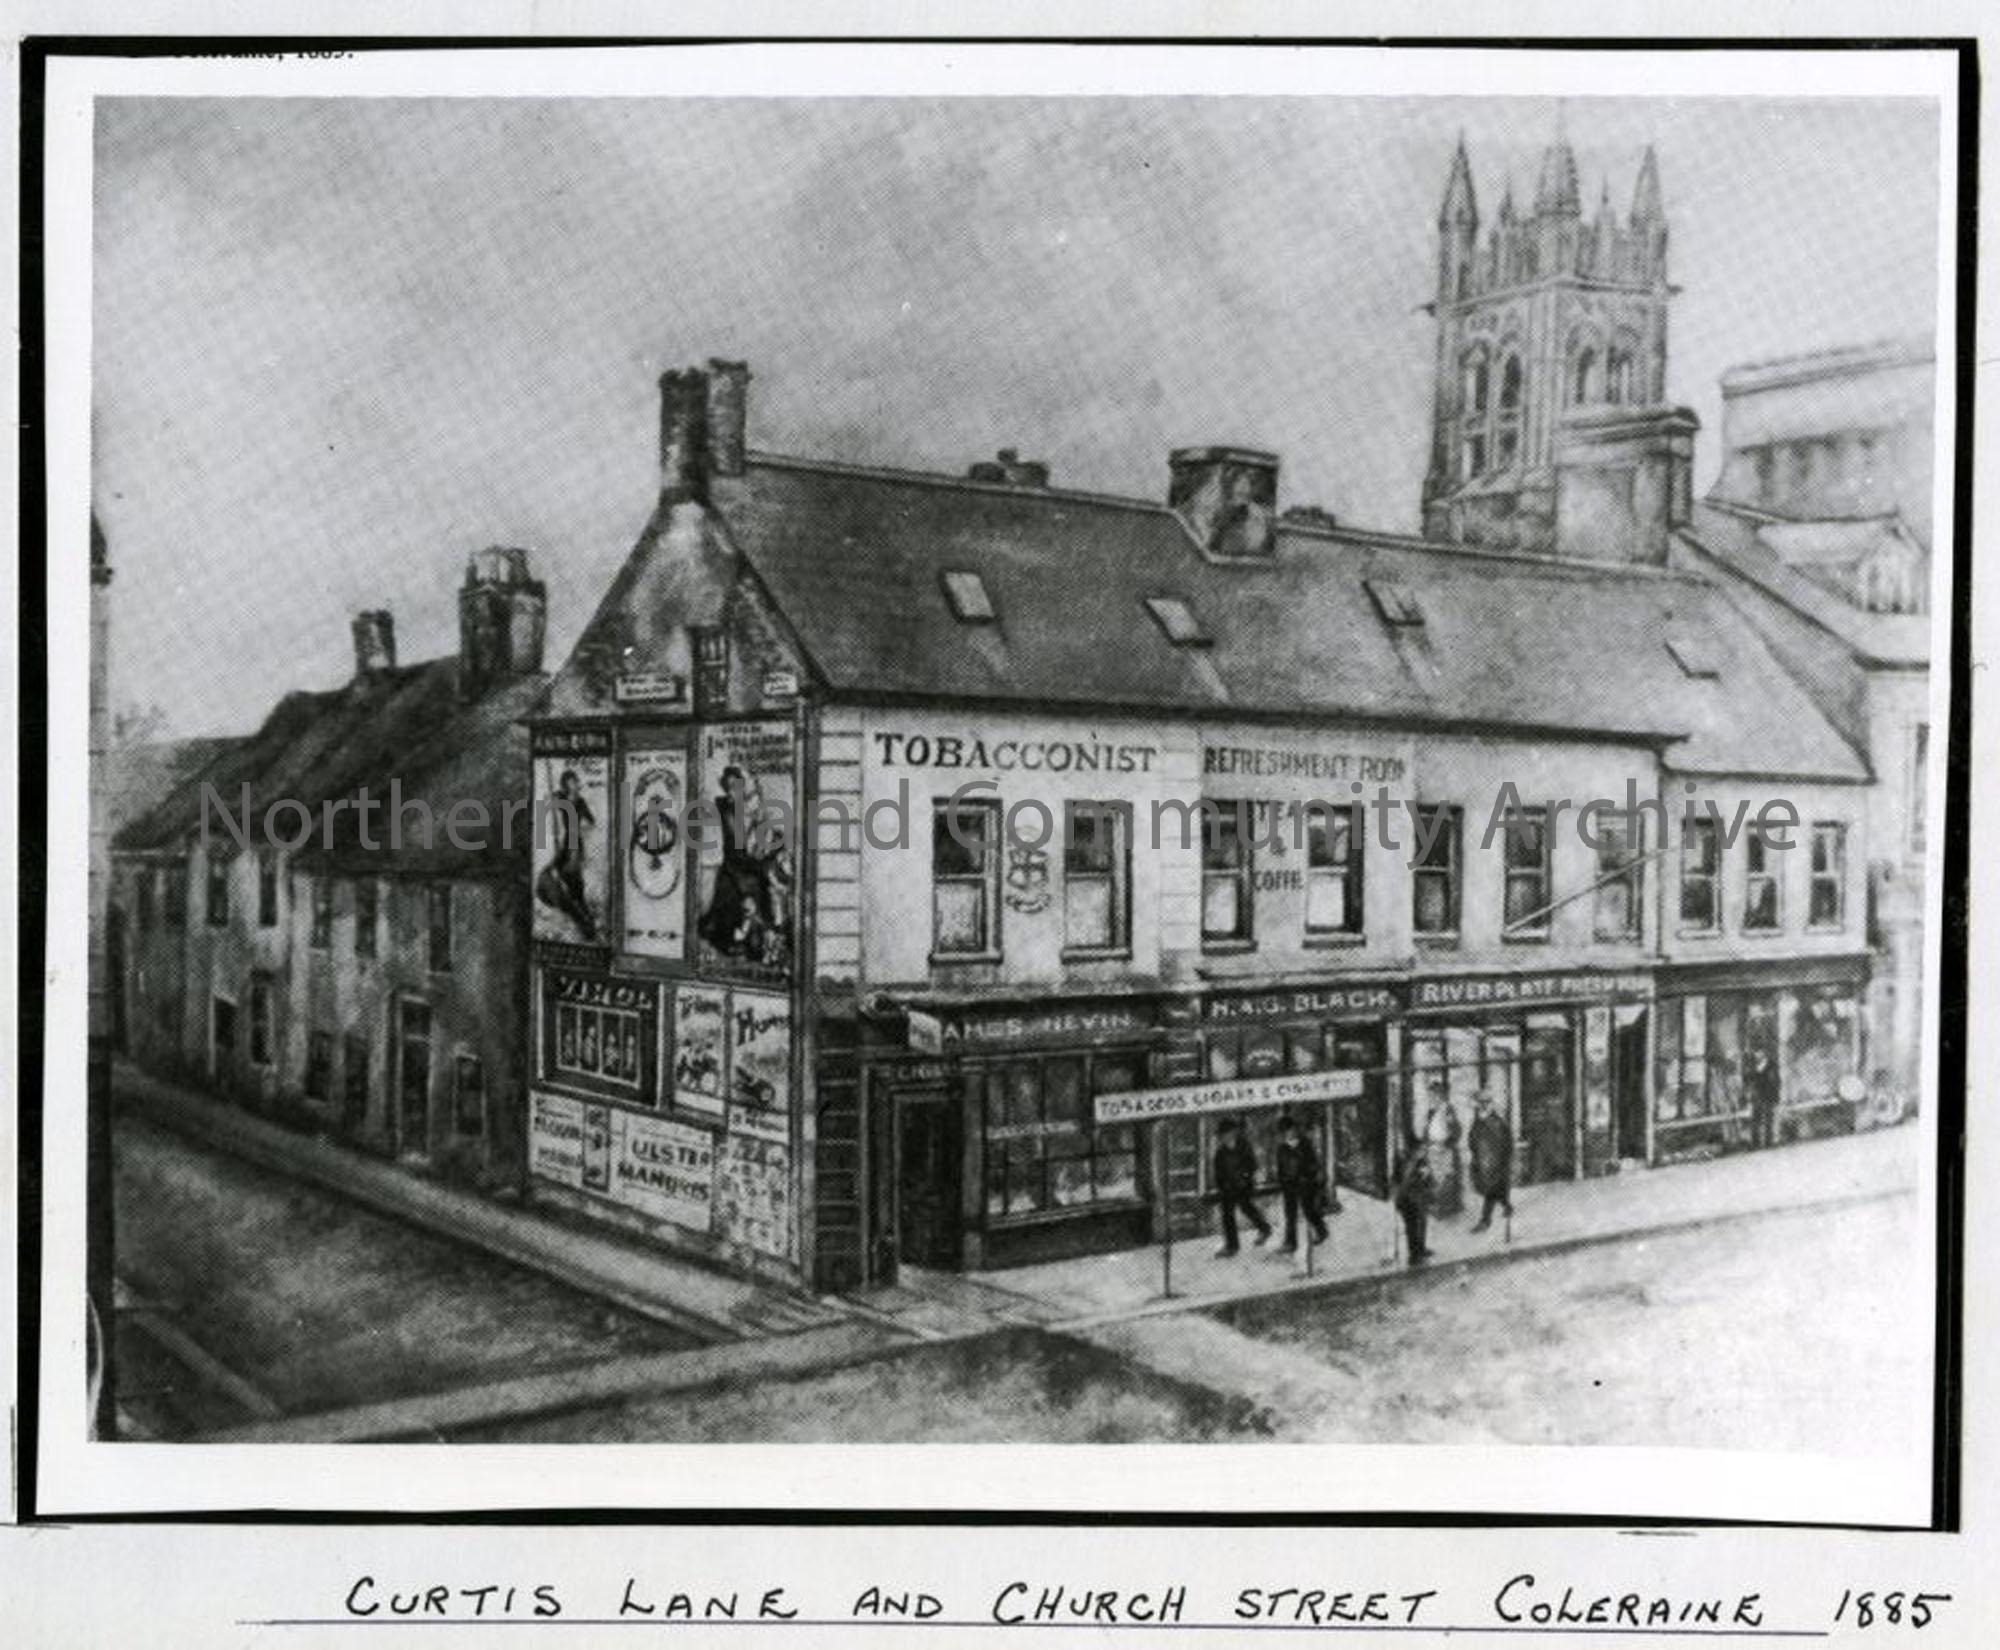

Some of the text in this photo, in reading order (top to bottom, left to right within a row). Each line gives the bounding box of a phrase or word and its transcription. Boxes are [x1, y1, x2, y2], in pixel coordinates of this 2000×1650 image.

[875, 732, 1157, 773] TOBACCONIST
[1204, 747, 1350, 778] REFRESHMENT
[1422, 982, 1491, 1001] RIVER
[346, 1574, 1953, 1628] CURTIS LANE AND CHURCH STREET COLERAINE 1885
